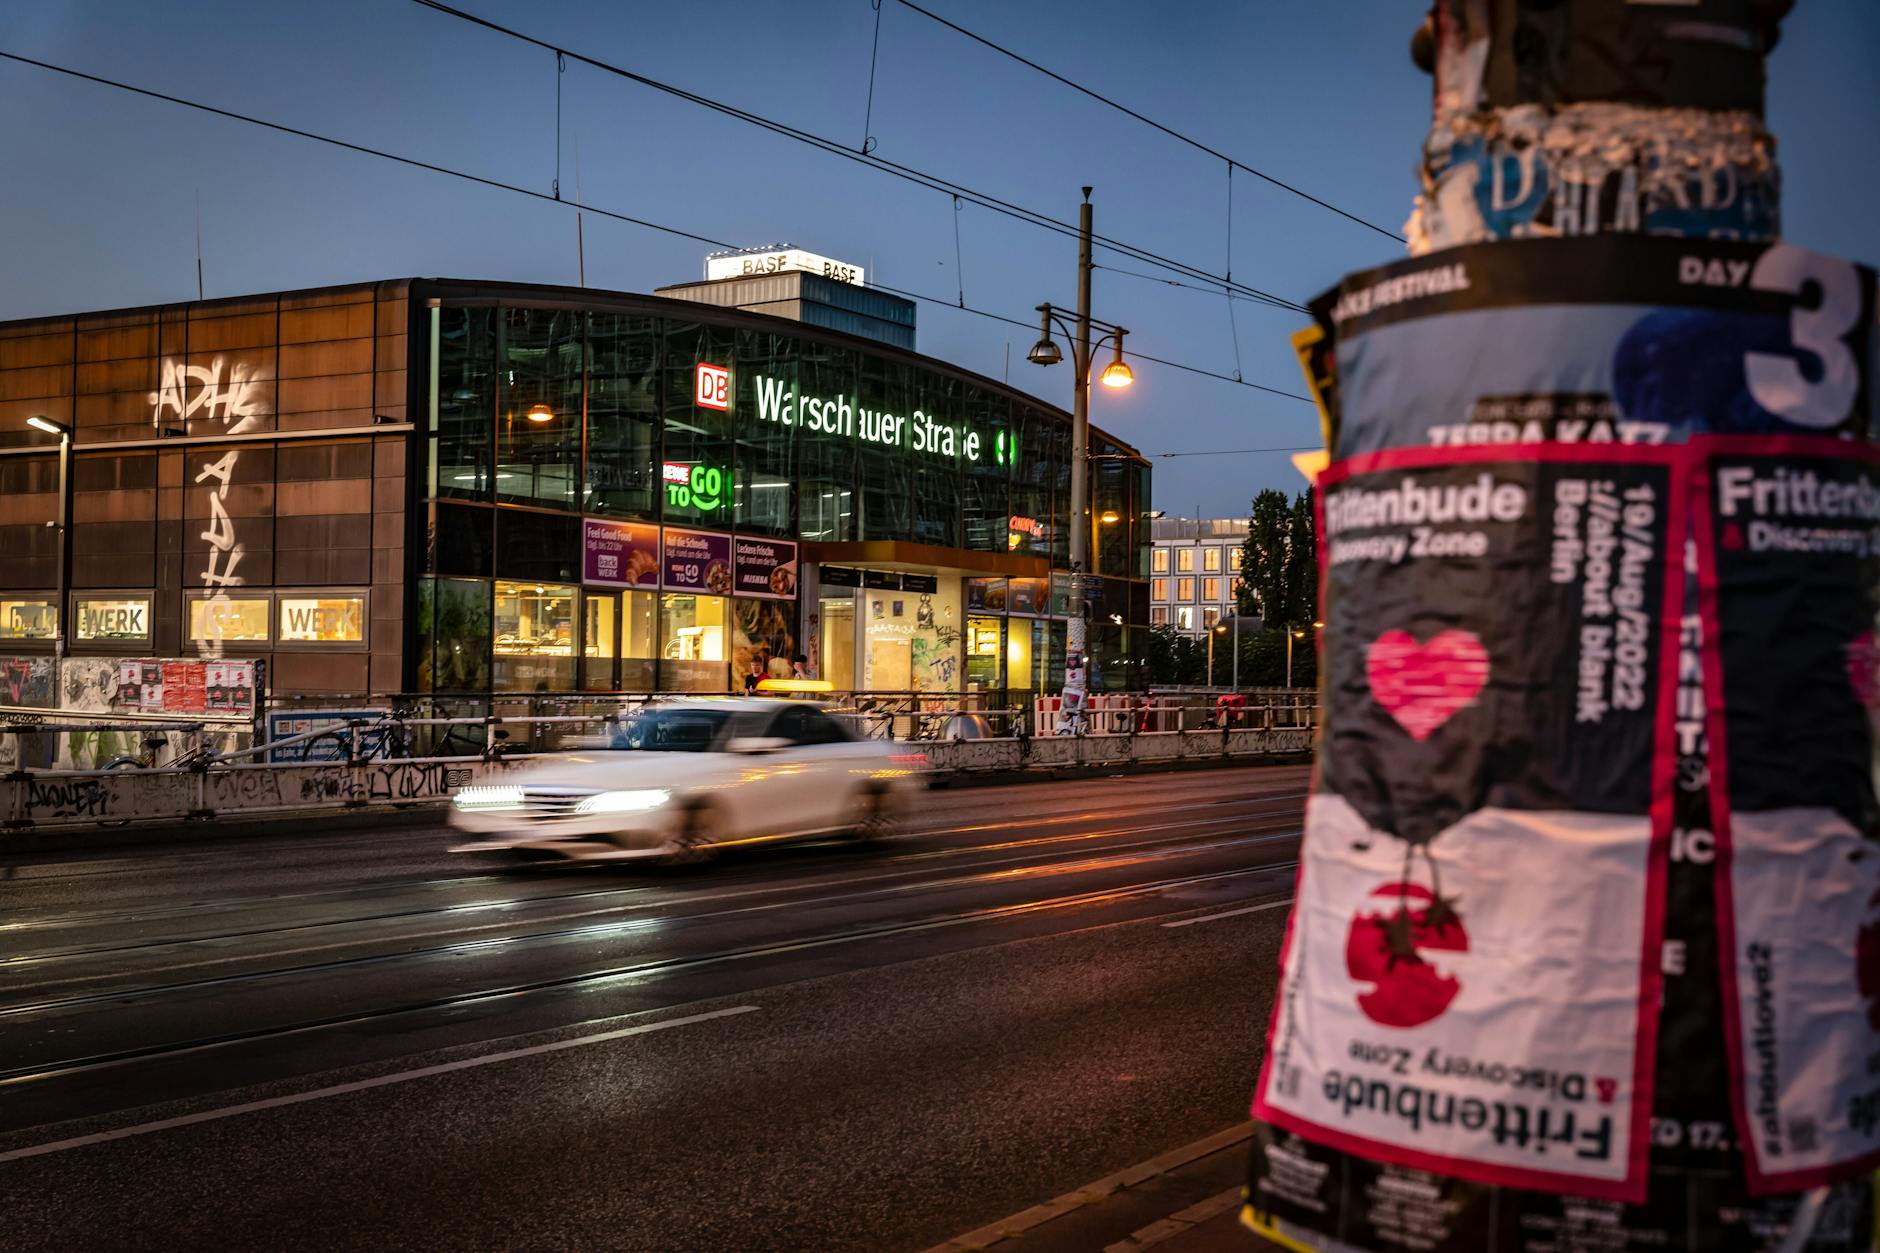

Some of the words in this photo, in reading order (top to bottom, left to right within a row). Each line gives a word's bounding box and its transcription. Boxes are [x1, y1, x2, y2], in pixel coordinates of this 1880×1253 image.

[743, 255, 787, 275] BASF
[823, 262, 856, 283] BASF
[1679, 256, 1749, 287] DAY
[1744, 245, 1862, 429] 3
[700, 369, 728, 405] DB
[755, 374, 905, 446] Warschauer
[912, 410, 980, 461] Strae
[668, 484, 691, 508] TO
[690, 466, 722, 497] GO
[1409, 527, 1488, 557] Zone
[1550, 478, 1588, 584] Berlin
[598, 568, 618, 578] WERK
[675, 573, 686, 582] TO
[685, 564, 699, 577] GO
[1612, 482, 1656, 711] 19/Aug/2022
[85, 609, 143, 632] WERK
[288, 608, 354, 633] WERK
[1575, 624, 1613, 723] blank
[1349, 1038, 1412, 1075] Zone
[1421, 1046, 1587, 1102] Discovery
[1322, 1070, 1613, 1160] Frittenbude
